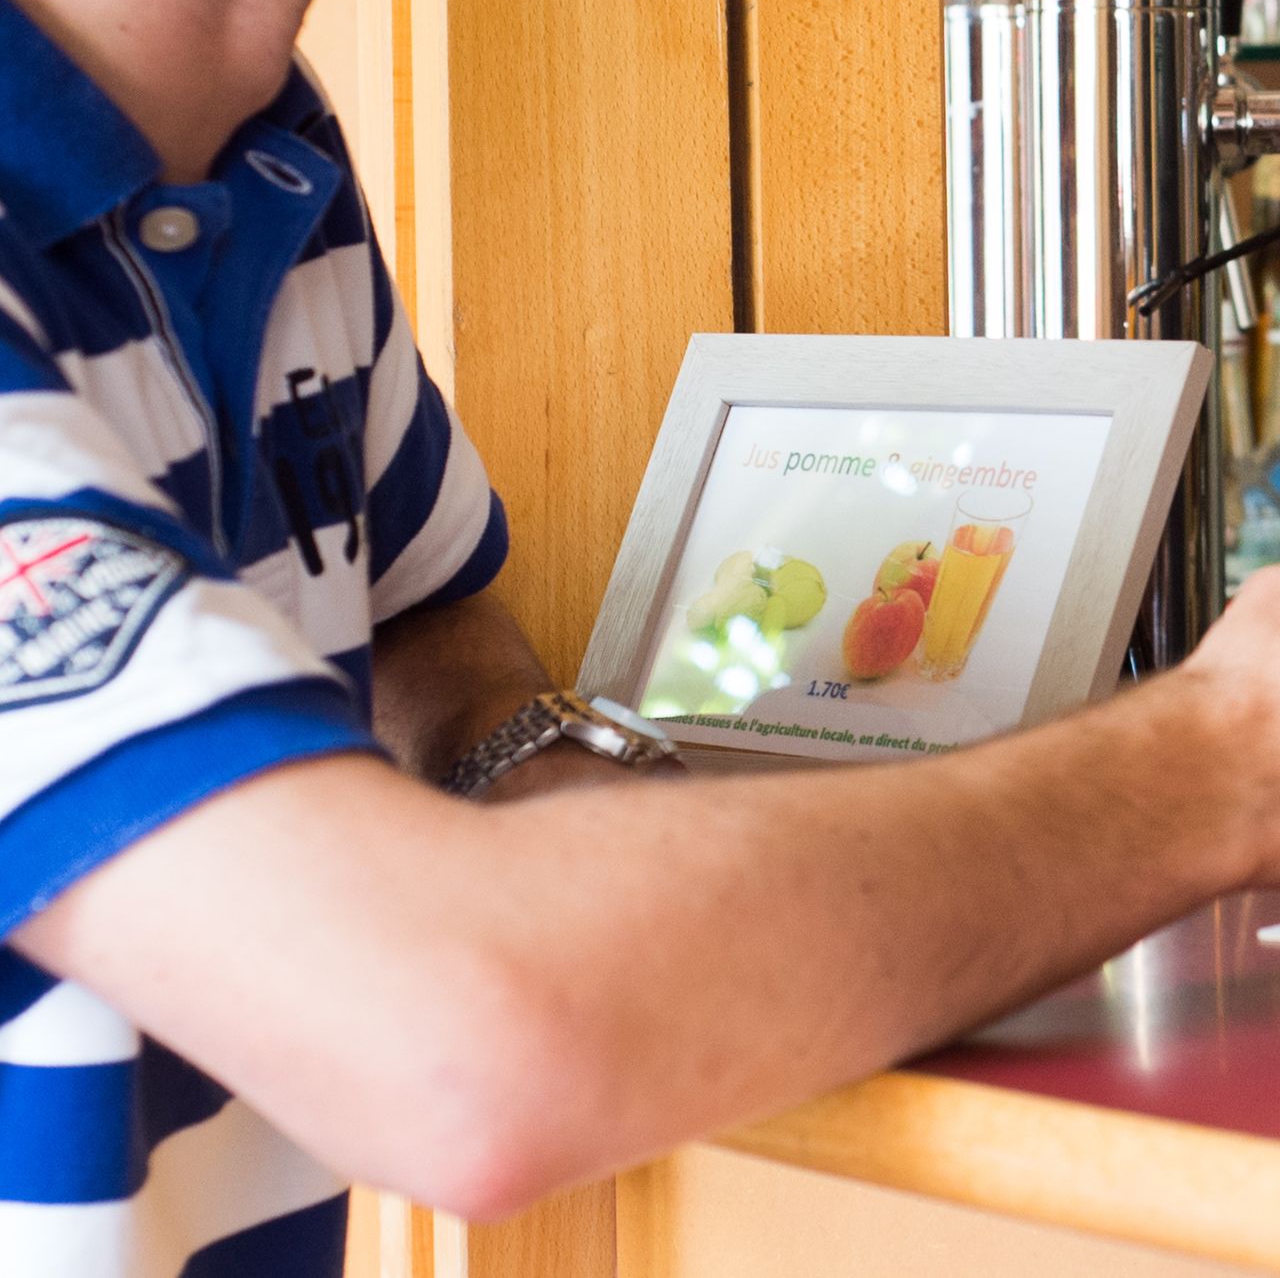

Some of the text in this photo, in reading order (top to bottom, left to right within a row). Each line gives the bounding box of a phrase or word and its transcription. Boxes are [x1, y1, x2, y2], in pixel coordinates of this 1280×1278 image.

[742, 442, 782, 470] Jus
[783, 451, 877, 477] pomme
[910, 455, 1038, 491] gingembre
[806, 679, 851, 701] 1.70€
[695, 714, 732, 729] issues
[733, 717, 748, 731] de
[749, 718, 819, 737] l'agriculture
[819, 726, 857, 746] locale,
[859, 734, 874, 746] en
[875, 733, 910, 750] direct
[911, 737, 927, 752] du
